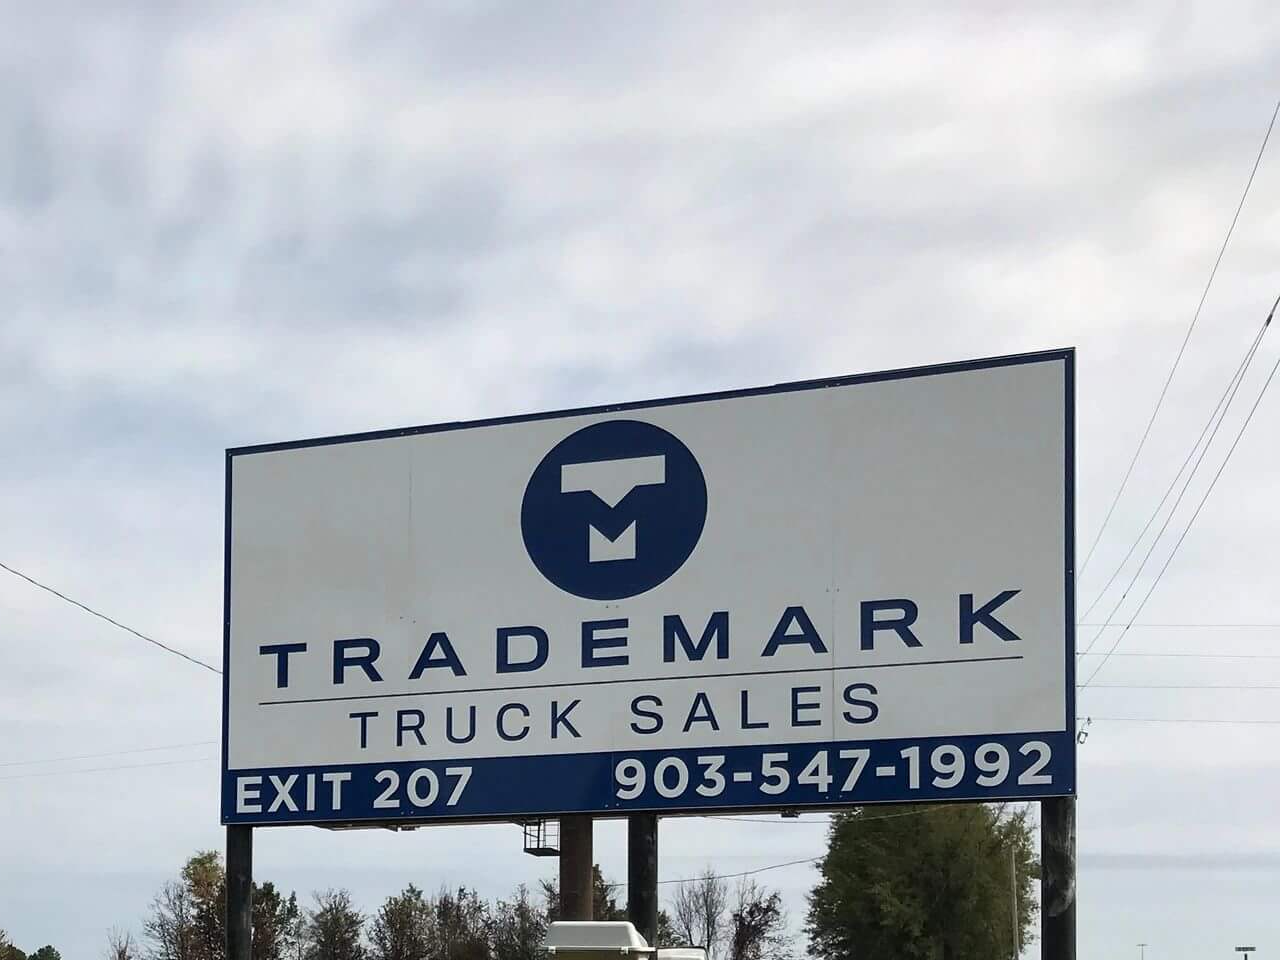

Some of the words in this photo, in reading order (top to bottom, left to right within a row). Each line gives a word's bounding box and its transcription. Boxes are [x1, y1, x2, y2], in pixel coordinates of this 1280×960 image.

[258, 589, 1024, 690] TRADEMARK
[348, 699, 582, 749] TRUCK
[630, 683, 879, 735] SALES
[236, 772, 352, 814] EXIT
[373, 766, 473, 809] 207
[615, 740, 1053, 800] 903-547-1992
